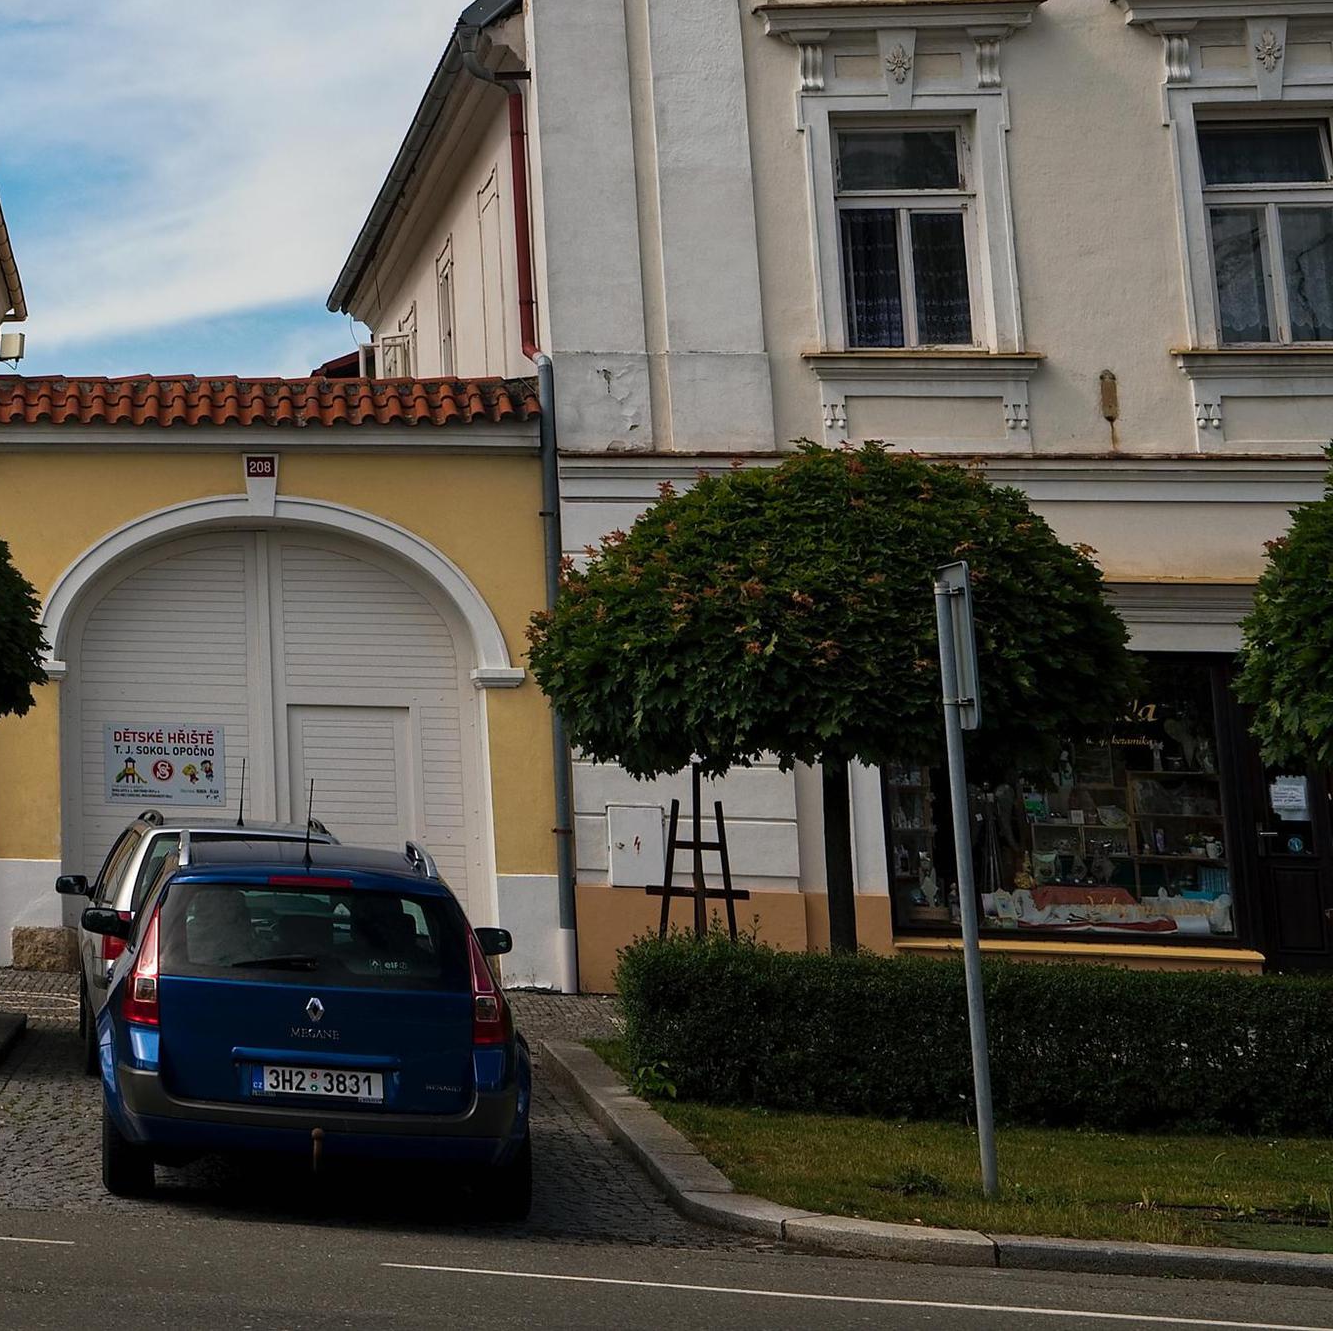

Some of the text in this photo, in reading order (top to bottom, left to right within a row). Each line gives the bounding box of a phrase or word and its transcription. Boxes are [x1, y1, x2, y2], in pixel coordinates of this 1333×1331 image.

[249, 461, 271, 473] 208
[113, 728, 214, 745] DĚTSKÉ HŘIŠTĚ
[114, 745, 123, 755] T.
[136, 745, 170, 755] SOKOL
[172, 745, 215, 757] OPOČNO
[289, 1027, 341, 1040] MEGANE
[268, 1069, 306, 1091] 3H2
[323, 1072, 373, 1096] 3831
